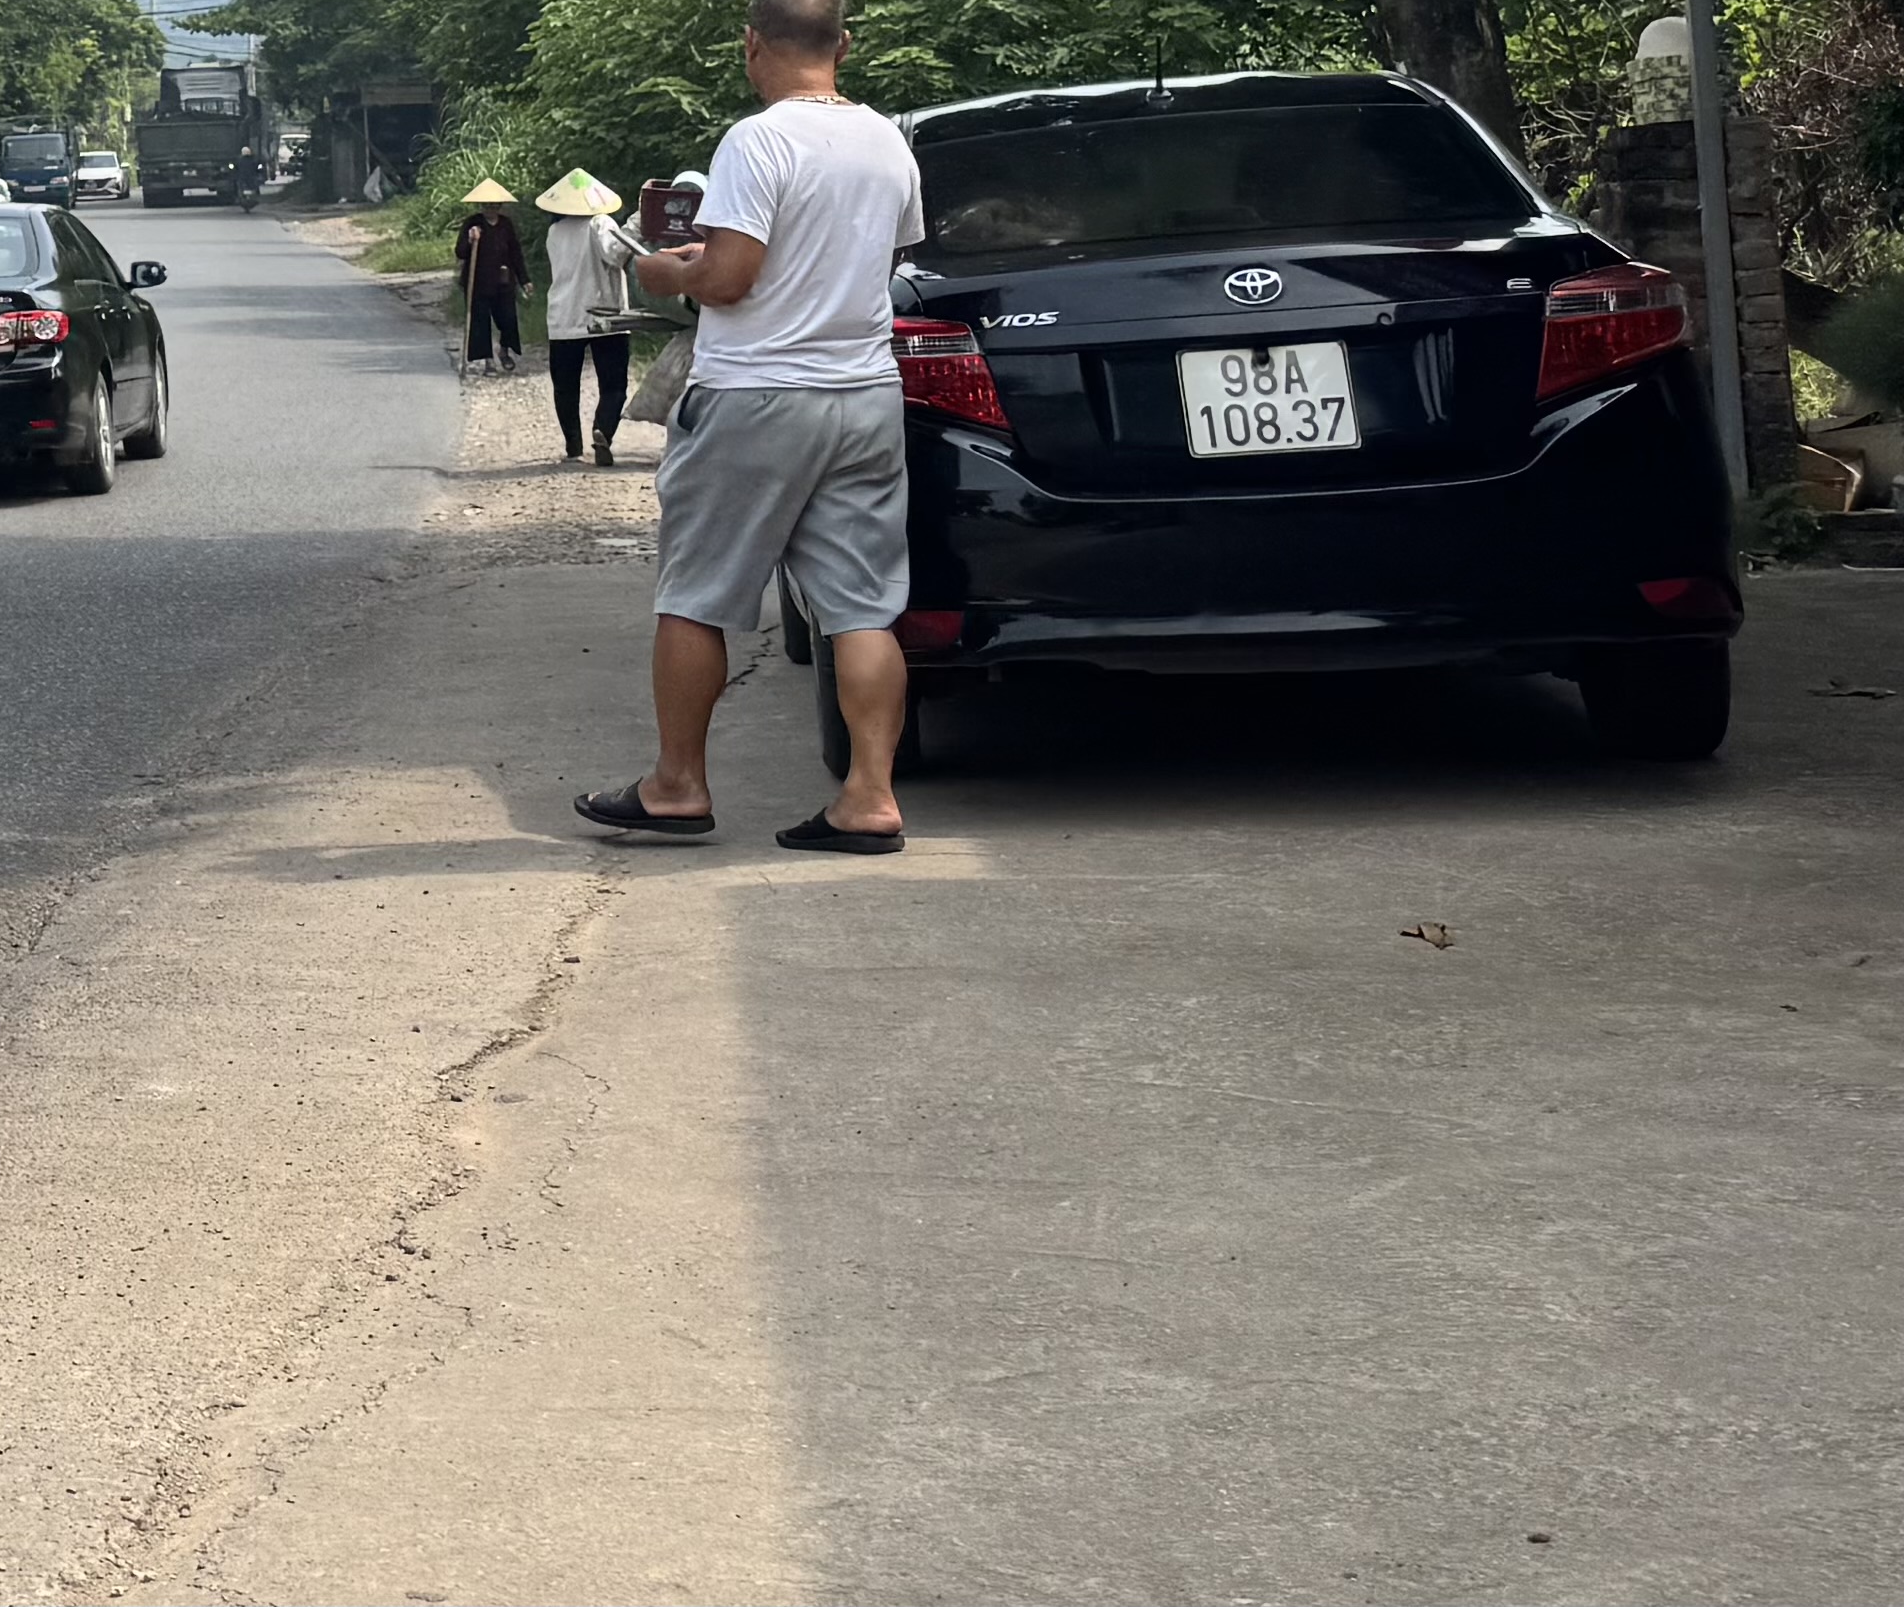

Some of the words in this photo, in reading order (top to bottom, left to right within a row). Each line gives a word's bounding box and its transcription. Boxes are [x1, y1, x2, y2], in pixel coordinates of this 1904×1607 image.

[979, 311, 1060, 329] VIOS
[1220, 350, 1309, 397] 98A
[1200, 396, 1345, 449] 108.37
